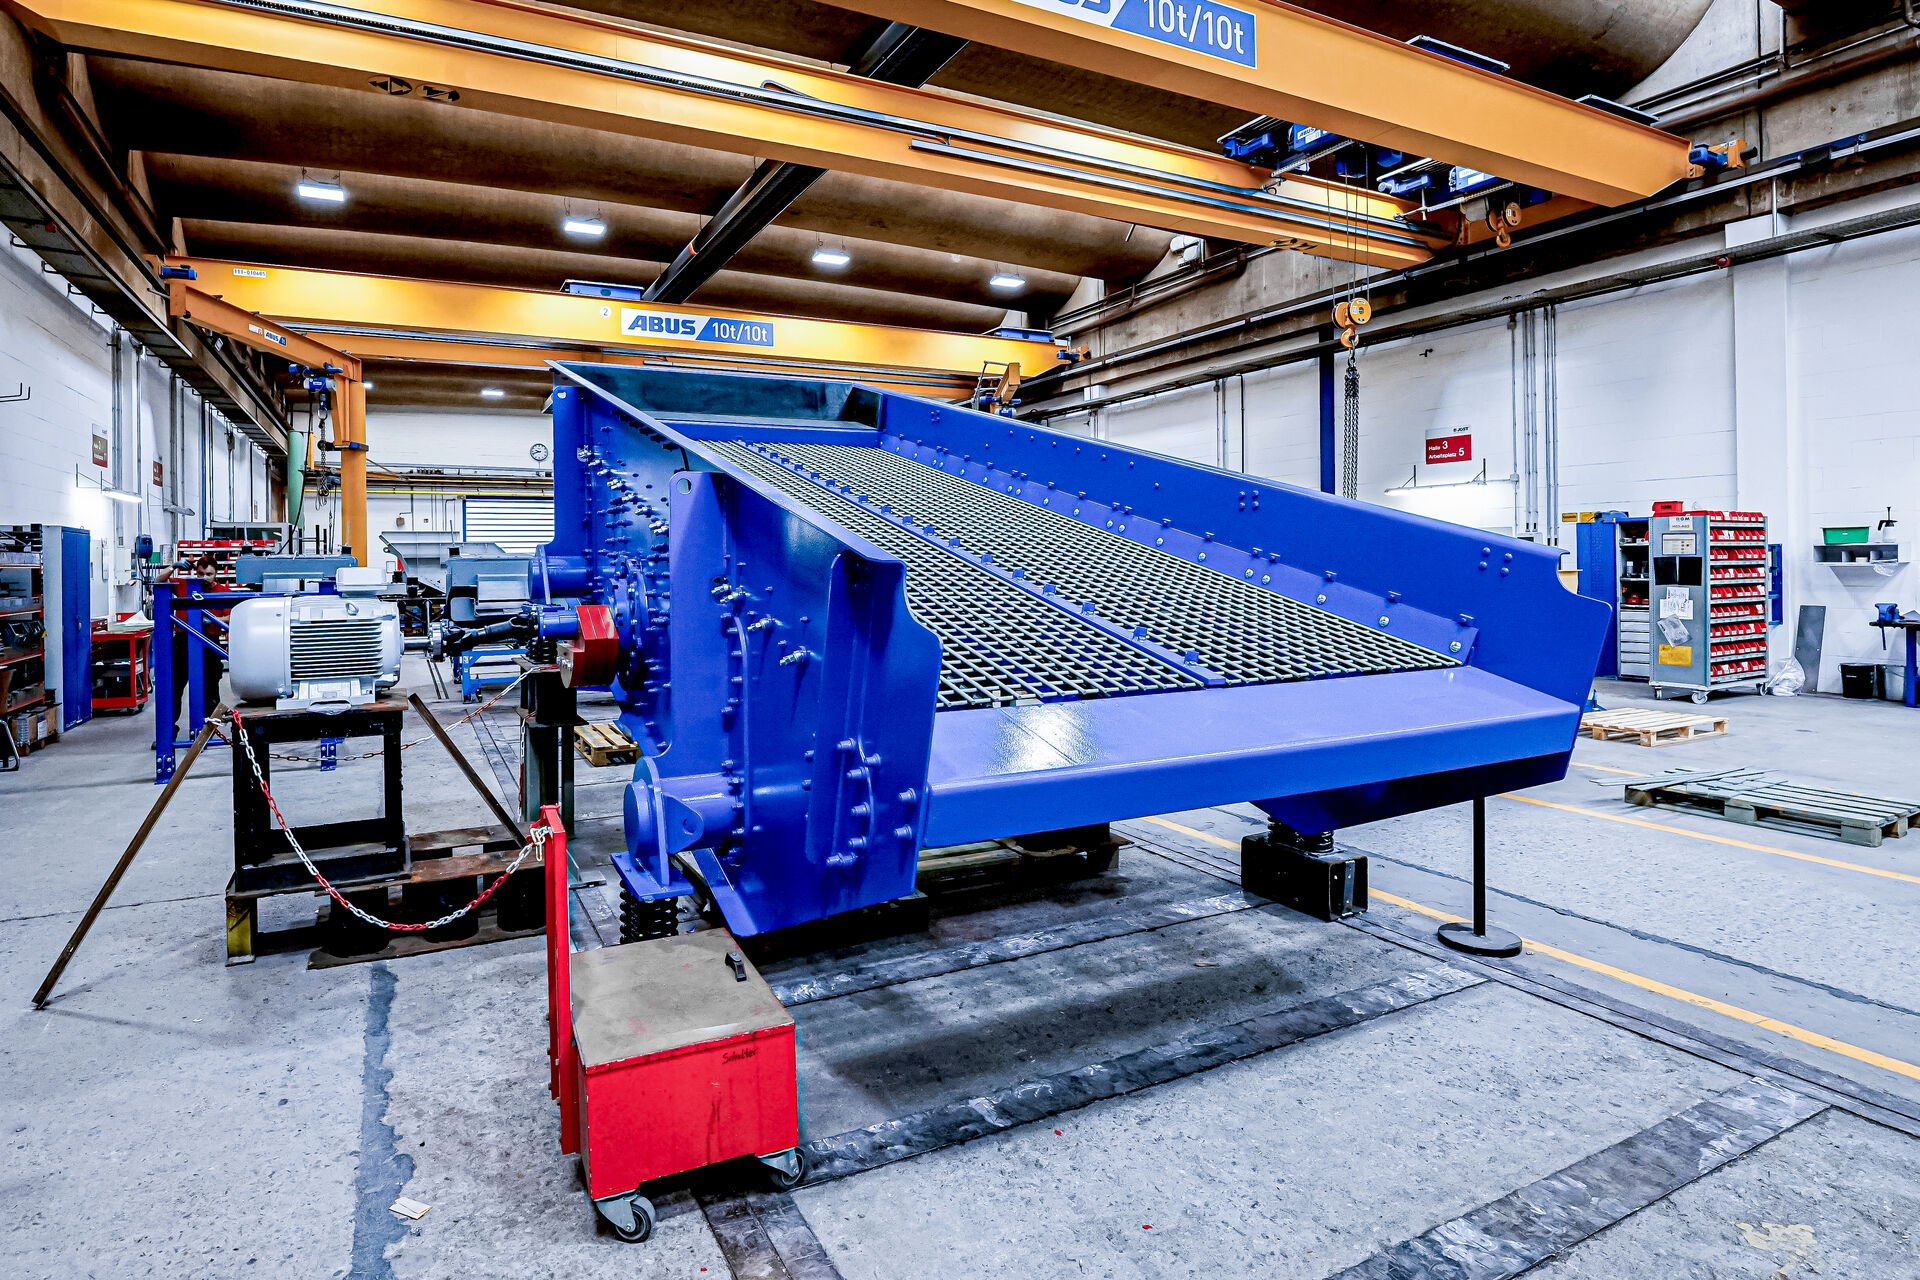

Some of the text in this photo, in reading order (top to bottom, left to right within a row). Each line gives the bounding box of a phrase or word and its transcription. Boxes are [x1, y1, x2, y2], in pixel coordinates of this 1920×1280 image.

[1144, 0, 1245, 54] 10t/10t
[603, 307, 609, 317] 2
[628, 315, 768, 343] ABUS 10t/10t
[1442, 440, 1449, 450] 3
[1458, 447, 1465, 457] 5
